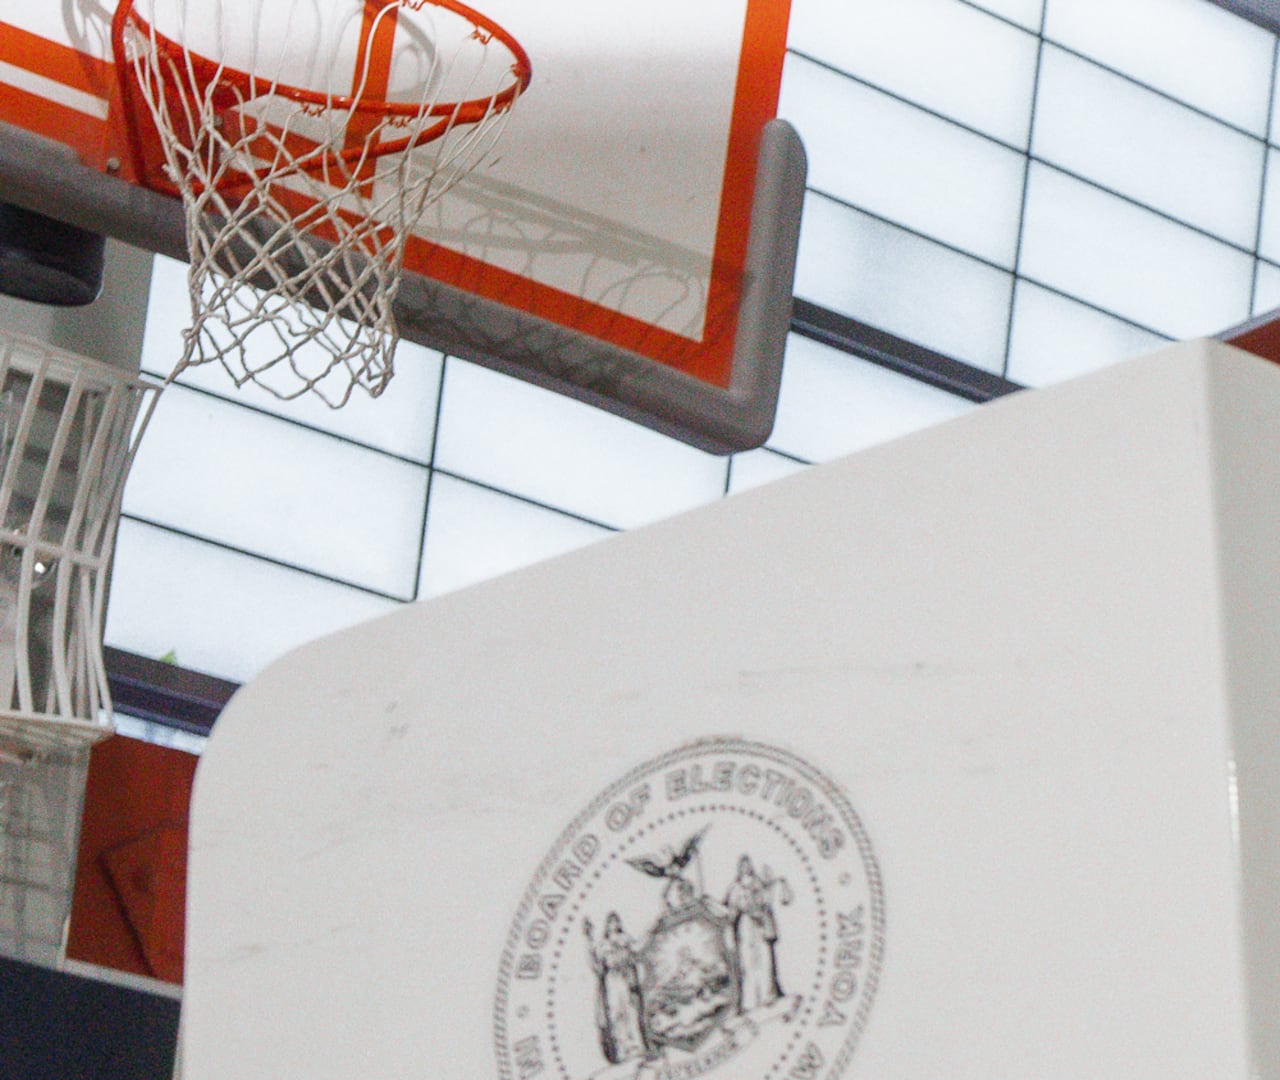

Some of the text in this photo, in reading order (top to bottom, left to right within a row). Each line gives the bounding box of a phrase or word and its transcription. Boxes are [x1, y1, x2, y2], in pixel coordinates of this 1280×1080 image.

[517, 761, 847, 982] BOARD OF ELECTIONS
[817, 903, 866, 1031] YORK
